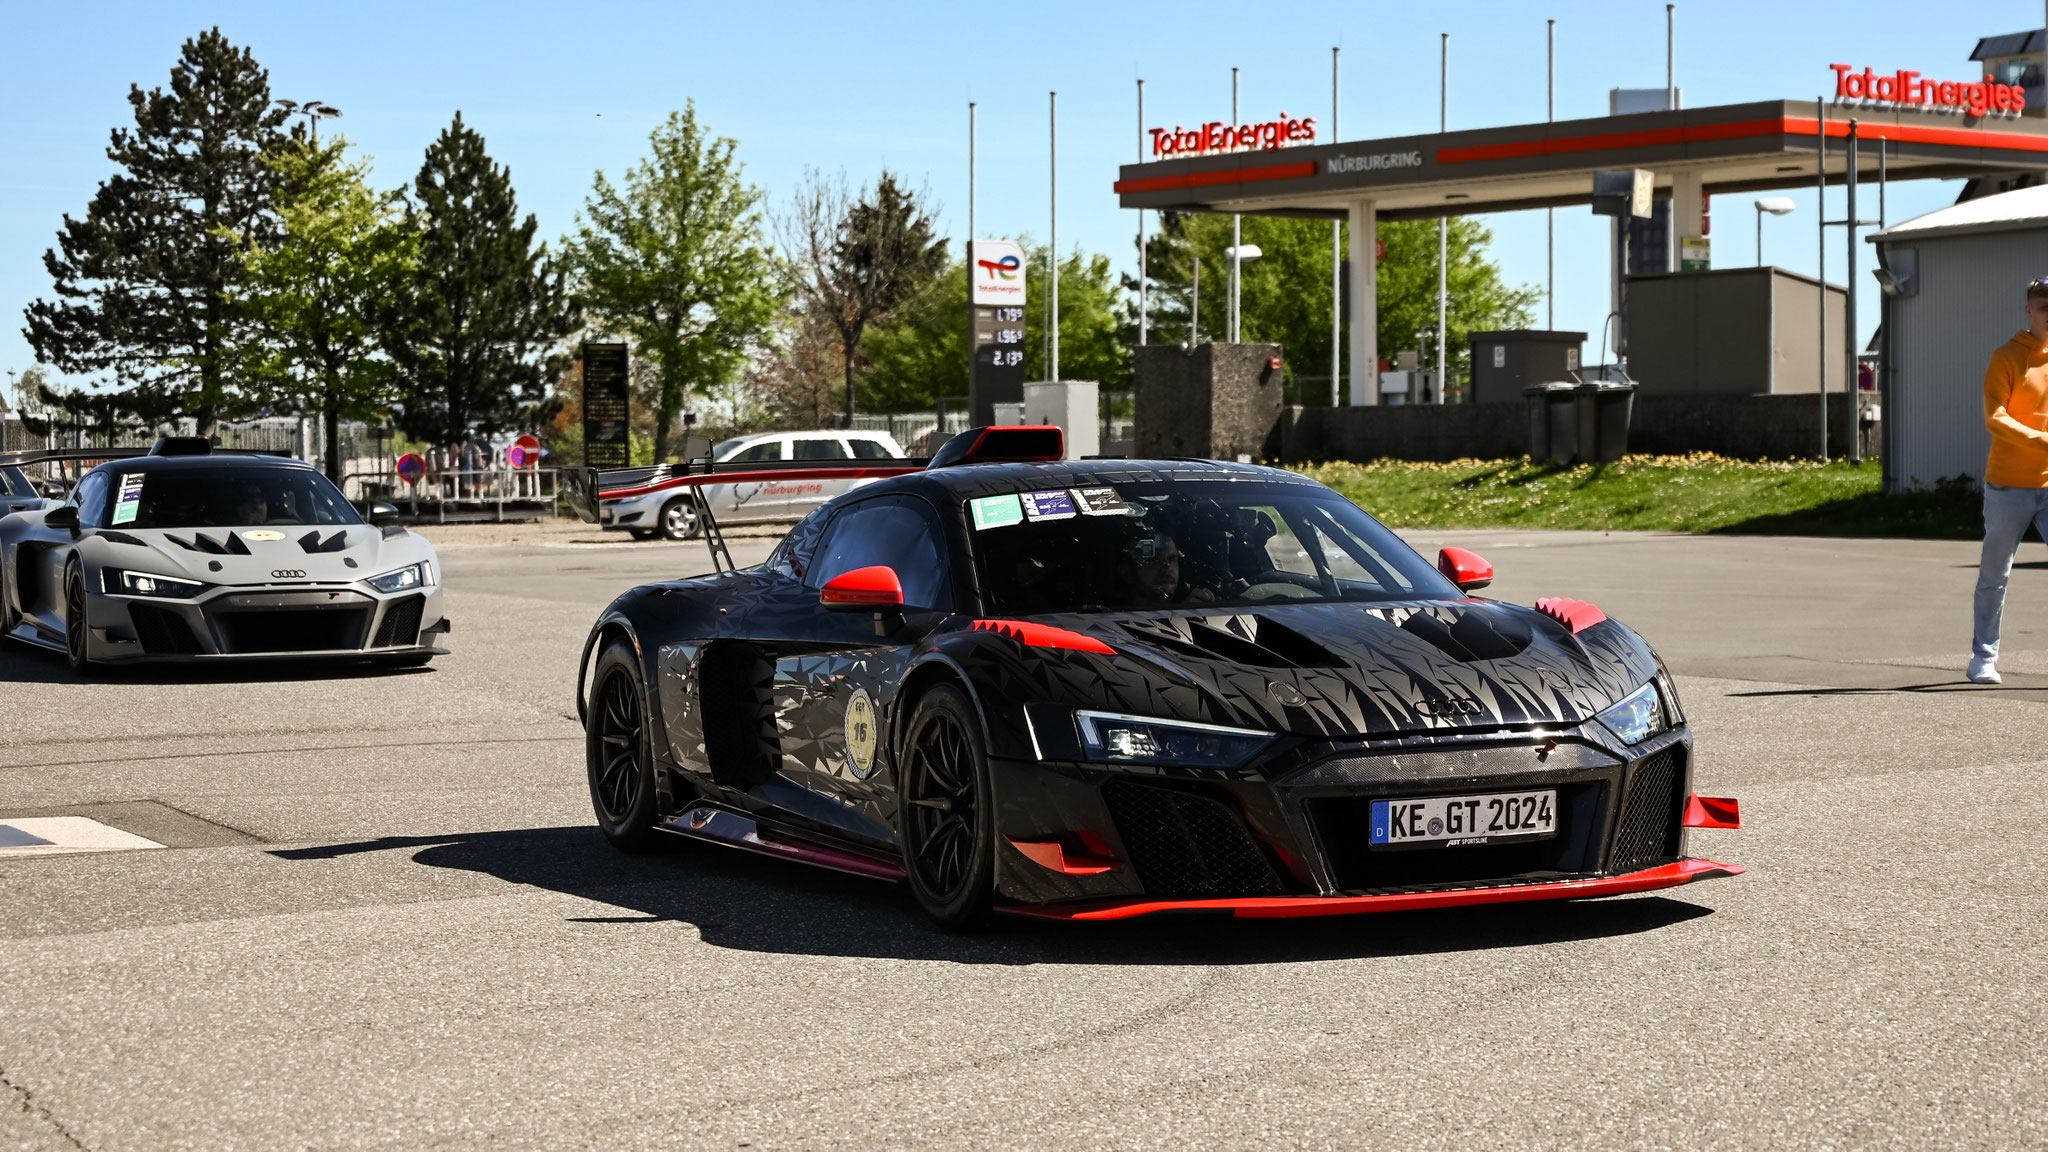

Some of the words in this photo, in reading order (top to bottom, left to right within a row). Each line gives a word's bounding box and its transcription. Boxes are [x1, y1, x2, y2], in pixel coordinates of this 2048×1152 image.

[1829, 63, 2026, 117] TotalEnergies
[1148, 111, 1317, 153] TotalEnergies
[1327, 150, 1422, 174] NÜRBURGRING
[978, 285, 1022, 295] TotalEnergies
[1020, 493, 1040, 516] RACE
[853, 722, 868, 743] 16
[1391, 803, 1425, 838] KE
[1446, 800, 1480, 834] GT
[1488, 795, 1552, 831] 2024
[1376, 827, 1383, 837] D
[1446, 839, 1461, 847] ABT
